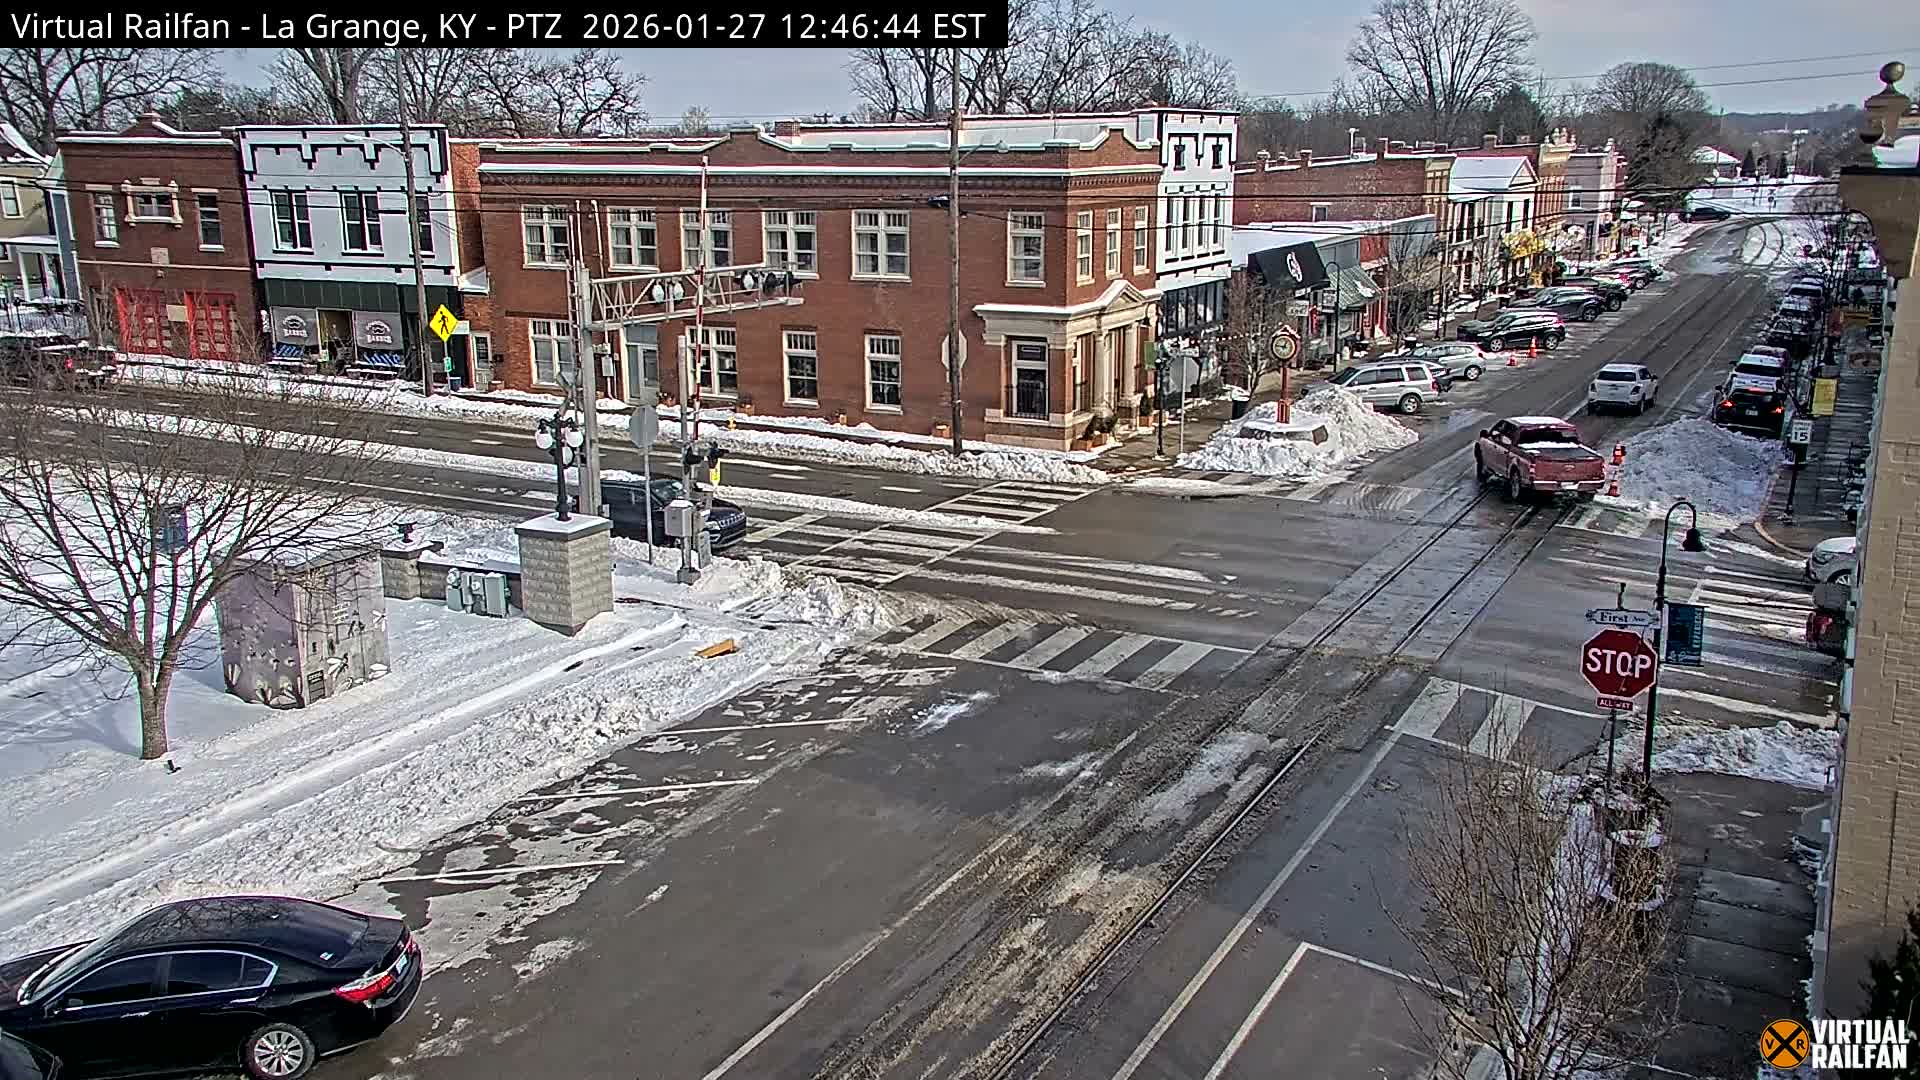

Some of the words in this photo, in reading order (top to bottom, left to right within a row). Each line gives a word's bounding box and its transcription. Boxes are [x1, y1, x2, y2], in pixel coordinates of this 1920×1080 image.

[1794, 431, 1808, 441] 15
[1600, 611, 1628, 622] First
[1585, 647, 1652, 679] STOP
[1599, 699, 1612, 707] ALL
